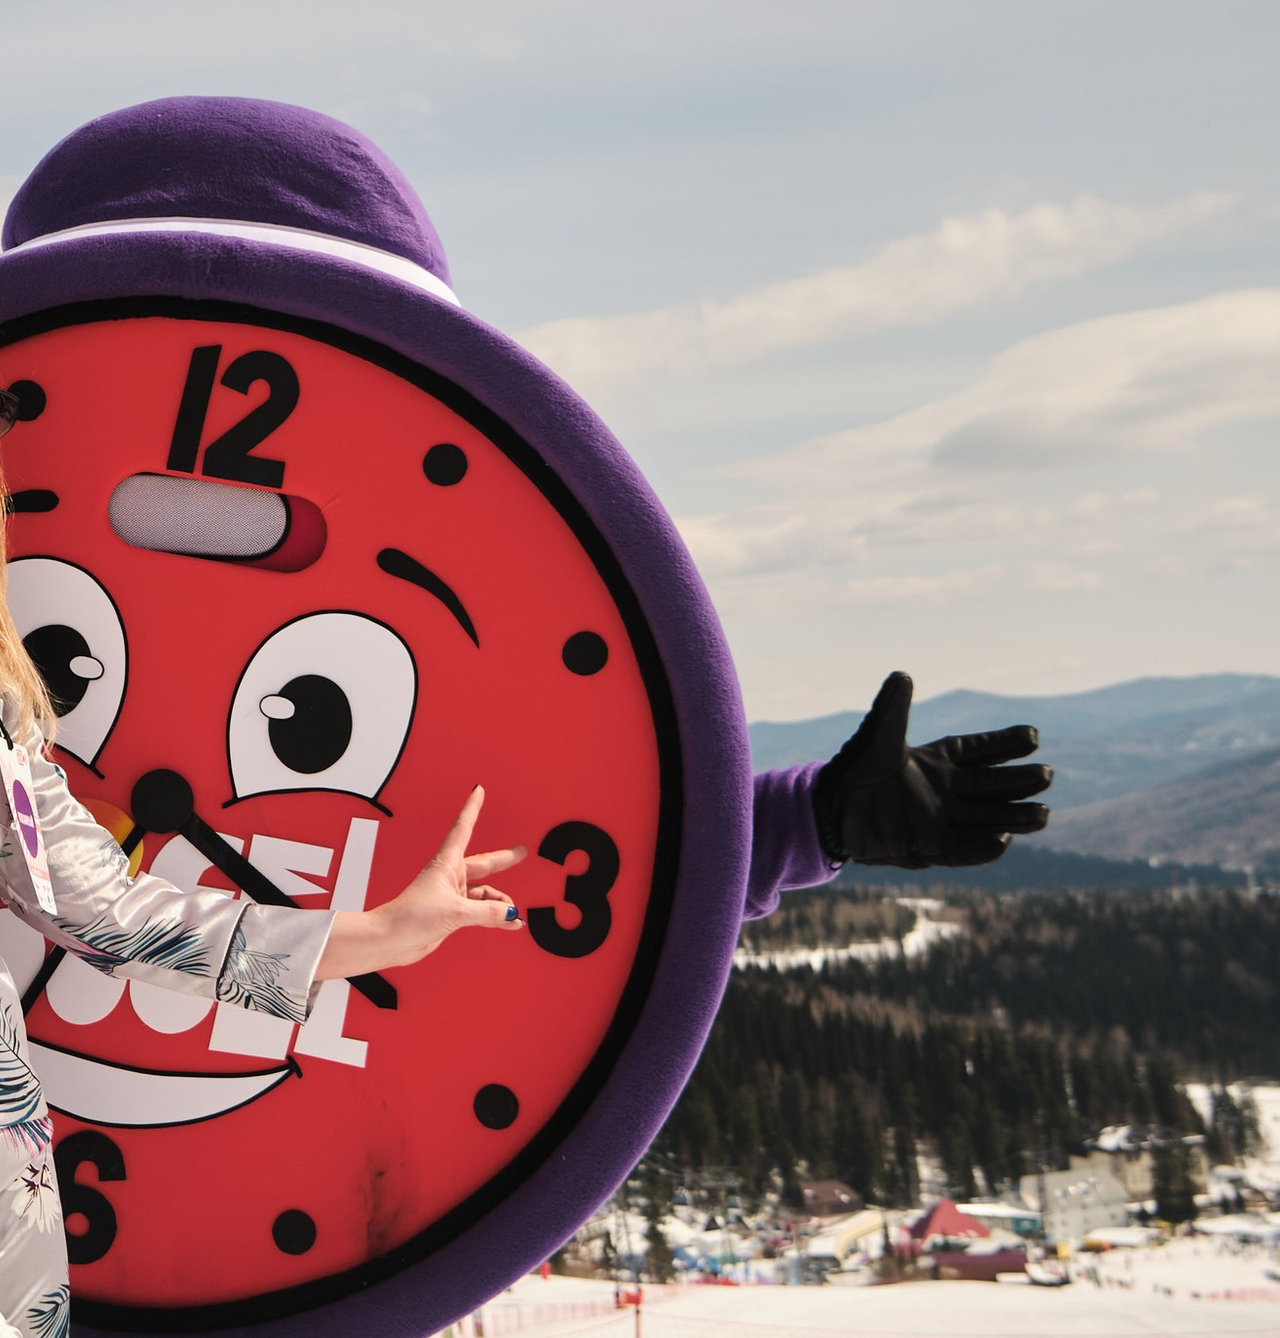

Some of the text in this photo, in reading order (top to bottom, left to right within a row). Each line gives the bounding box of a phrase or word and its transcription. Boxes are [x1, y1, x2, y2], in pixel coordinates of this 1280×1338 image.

[166, 344, 300, 489] 12
[527, 821, 620, 958] 3
[53, 1129, 126, 1265] 6
